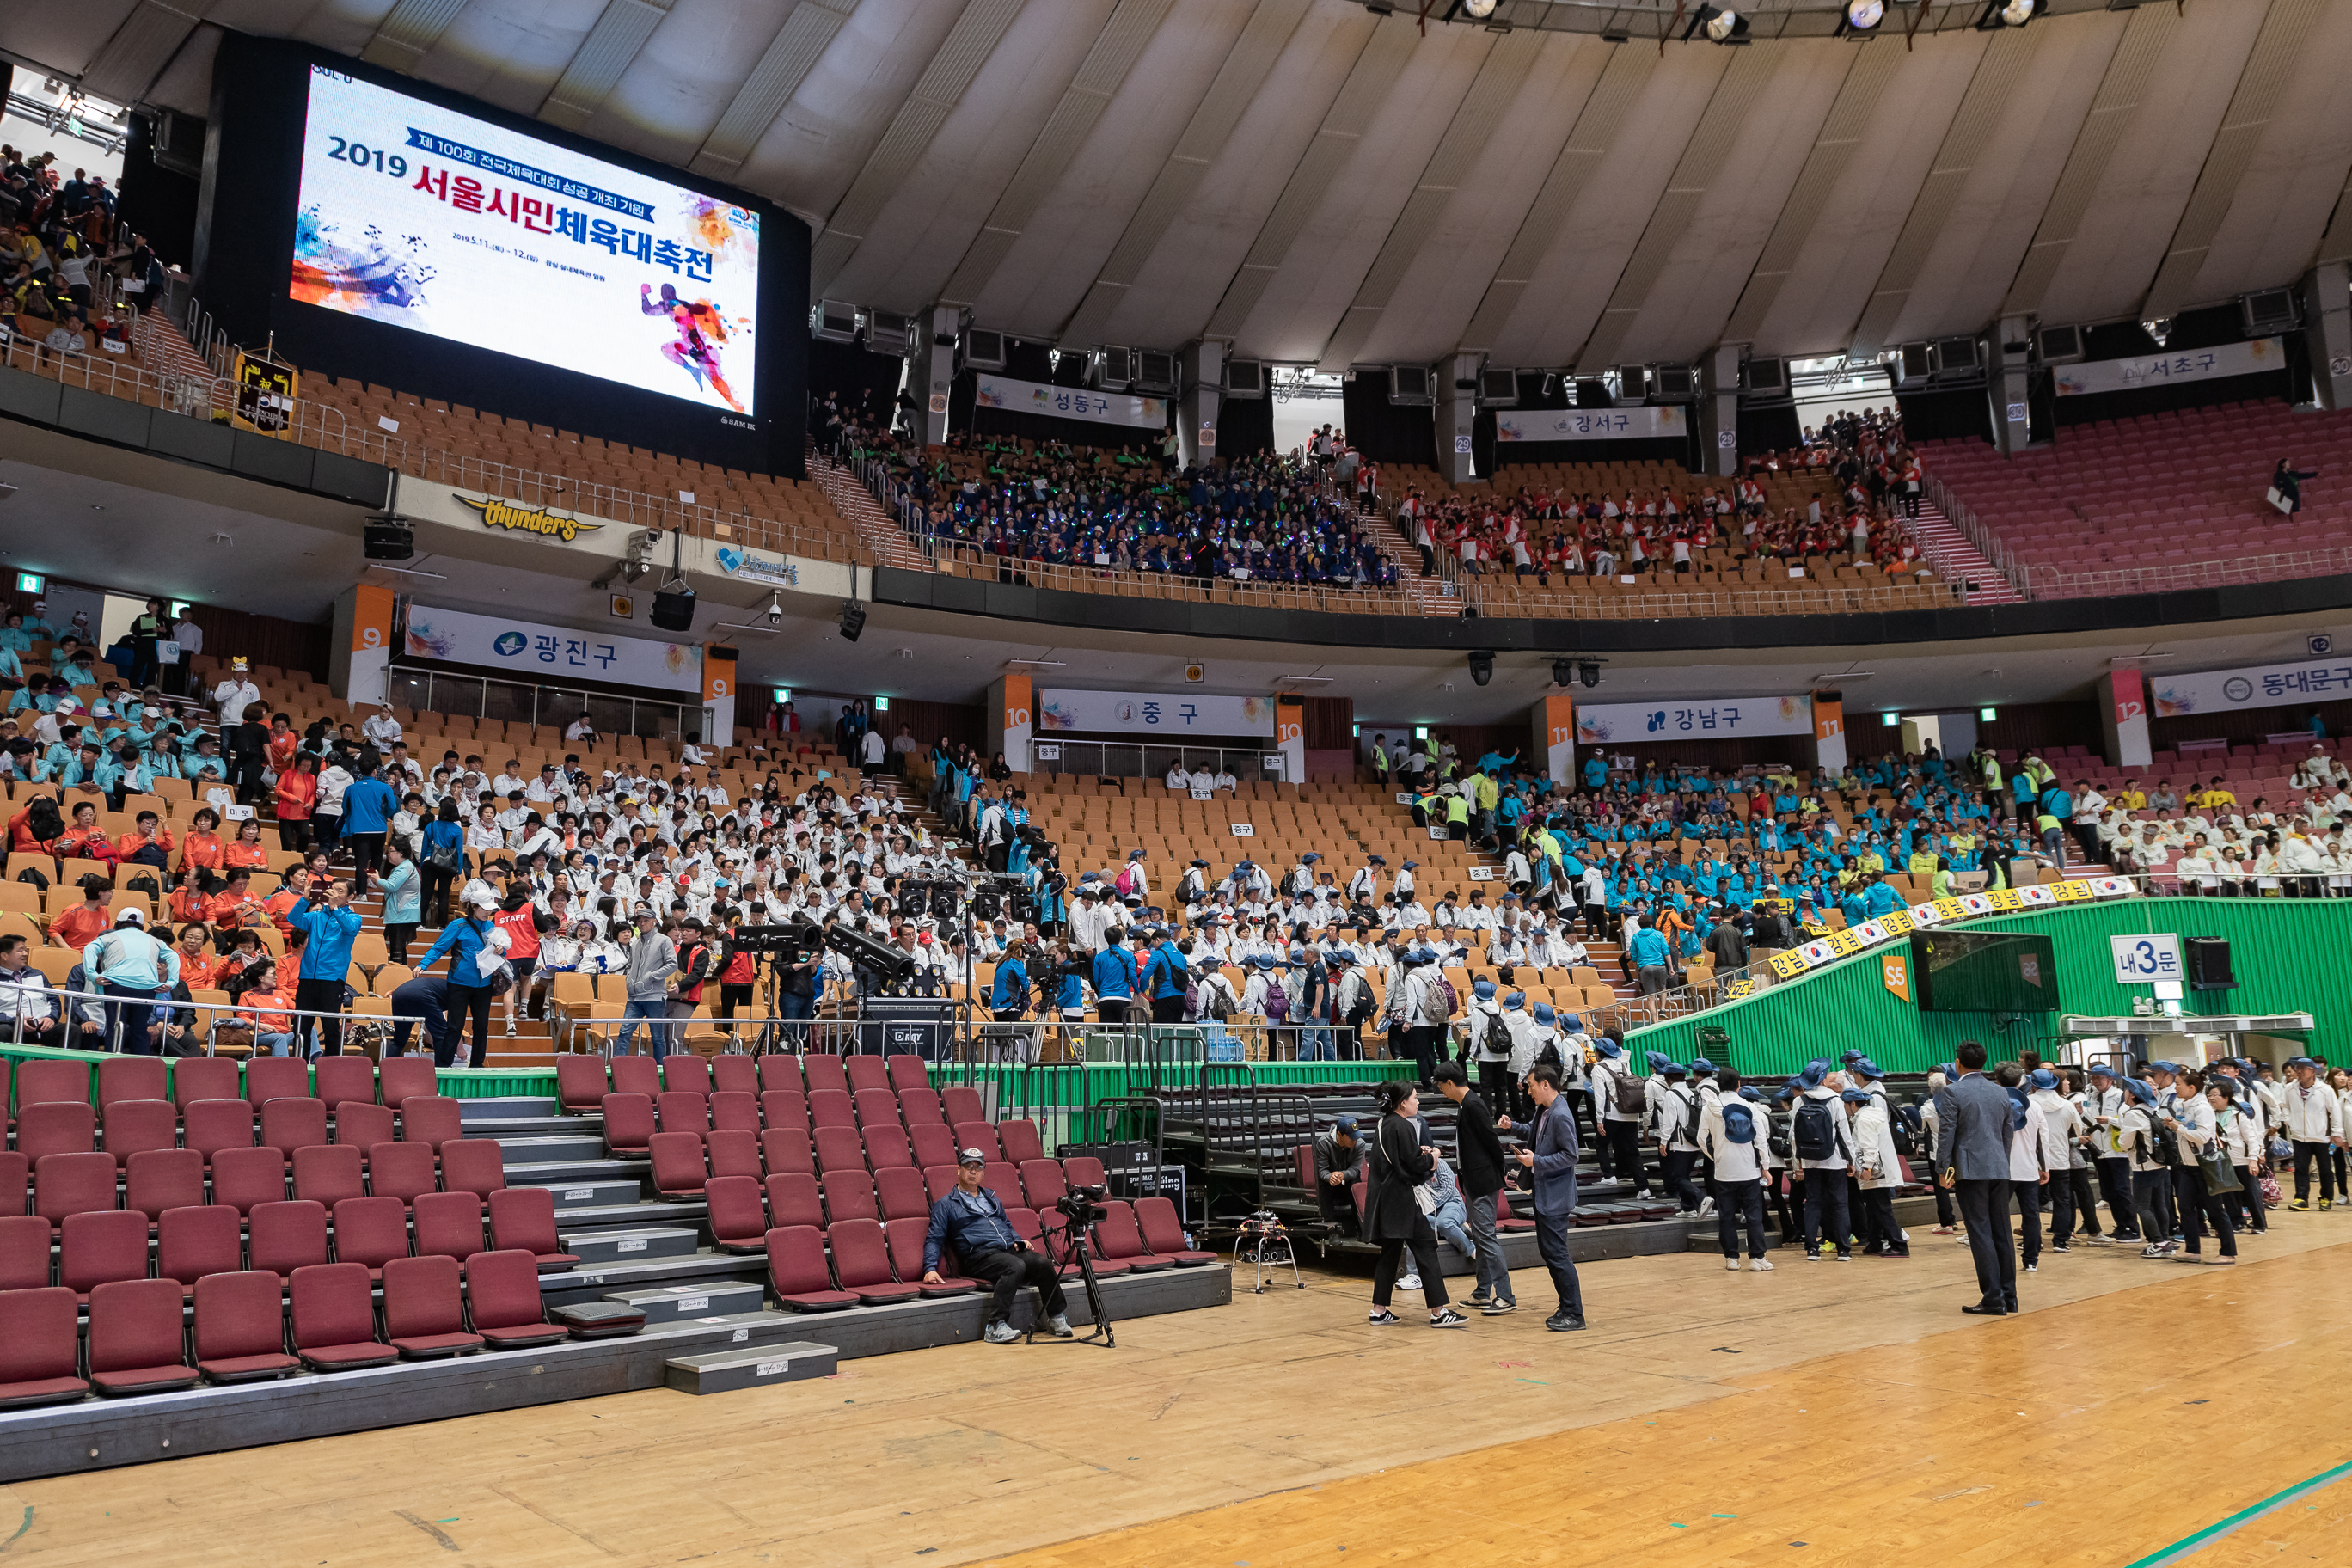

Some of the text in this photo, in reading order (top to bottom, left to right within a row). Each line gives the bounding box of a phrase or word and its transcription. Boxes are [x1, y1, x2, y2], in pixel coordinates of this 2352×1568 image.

[418, 133, 645, 218] 제 100회 전국체육대회 성공 개최 기원
[328, 136, 712, 283] 2019 서울시민체육대축전
[2150, 353, 2215, 377] 서초구
[932, 398, 946, 408] 28
[1054, 393, 1109, 414] 성동구
[2011, 407, 2024, 418] 30
[728, 418, 756, 431] SAM IK
[1576, 414, 1630, 432] 강서구
[1457, 438, 1469, 450] 29
[1721, 433, 1734, 444] 29
[485, 500, 578, 541] thunders
[619, 602, 625, 610] 9
[363, 628, 381, 649] 9
[2313, 640, 2328, 650] 12
[534, 634, 617, 670] 광진구
[1188, 670, 1200, 678] 10
[2262, 667, 2352, 696] 동대문구
[712, 679, 727, 698] 9
[1007, 708, 1030, 726] 10
[1675, 707, 1742, 731] 강남구
[2118, 701, 2141, 719] 12
[1279, 723, 1301, 740] 10
[1553, 727, 1568, 743] 11
[1822, 720, 1838, 736] 11
[1041, 747, 1057, 756] 중구
[1265, 758, 1281, 767] 중구
[1234, 825, 1251, 834] 중구
[1472, 868, 1491, 878] 중구
[2053, 881, 2089, 899] 강남
[1935, 899, 1964, 917] 강남
[1988, 890, 2019, 909] 강남
[499, 914, 526, 925] STAFF
[1882, 911, 1912, 933] 강남
[1828, 930, 1859, 954] 강남
[1772, 951, 1805, 975] 강남
[1886, 965, 1905, 986] S5
